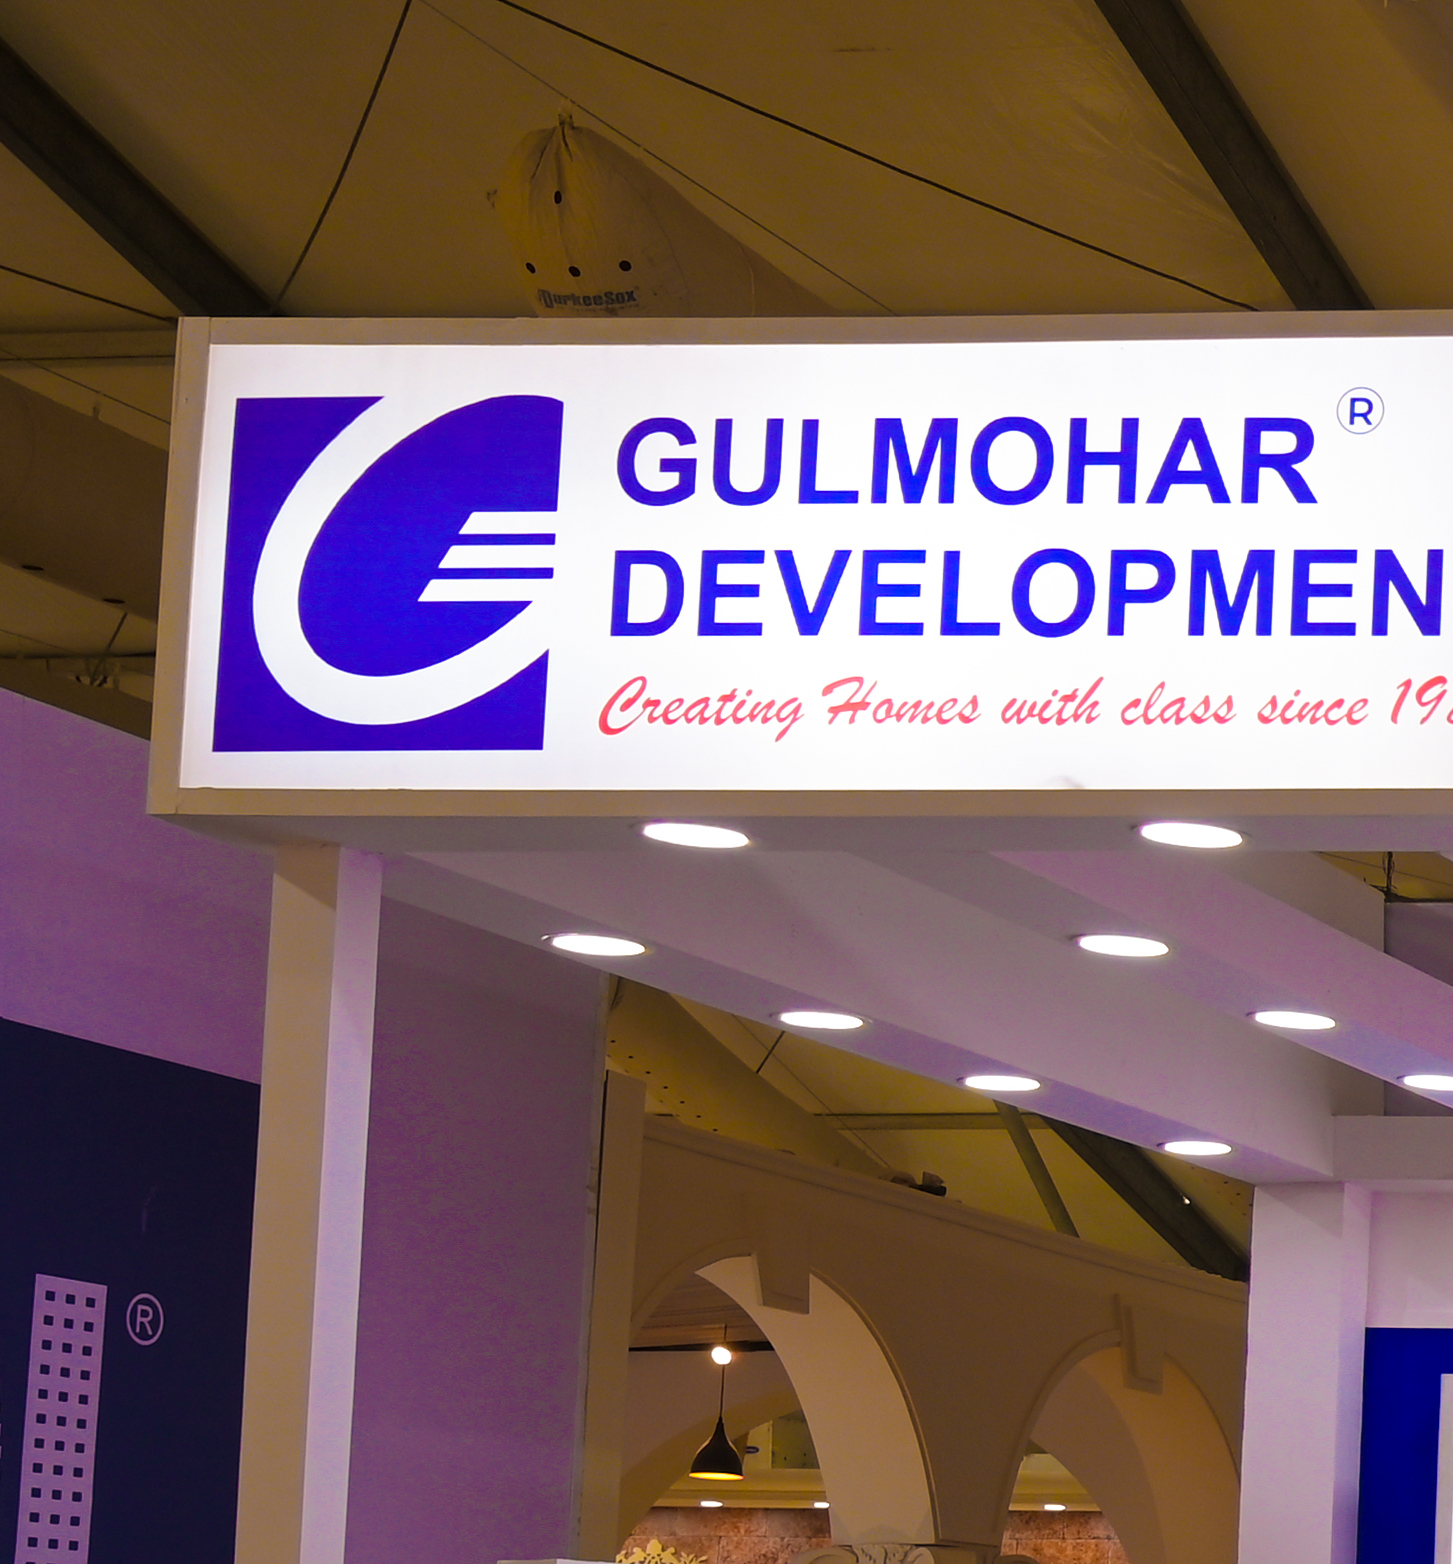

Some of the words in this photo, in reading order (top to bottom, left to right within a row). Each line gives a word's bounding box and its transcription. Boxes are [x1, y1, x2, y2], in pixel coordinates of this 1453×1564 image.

[617, 417, 1318, 506] GULMOHAR
[599, 676, 803, 742] Creating
[822, 677, 981, 725] Homes
[1001, 677, 1104, 726] with
[1121, 681, 1236, 725] class
[1257, 690, 1368, 726] since
